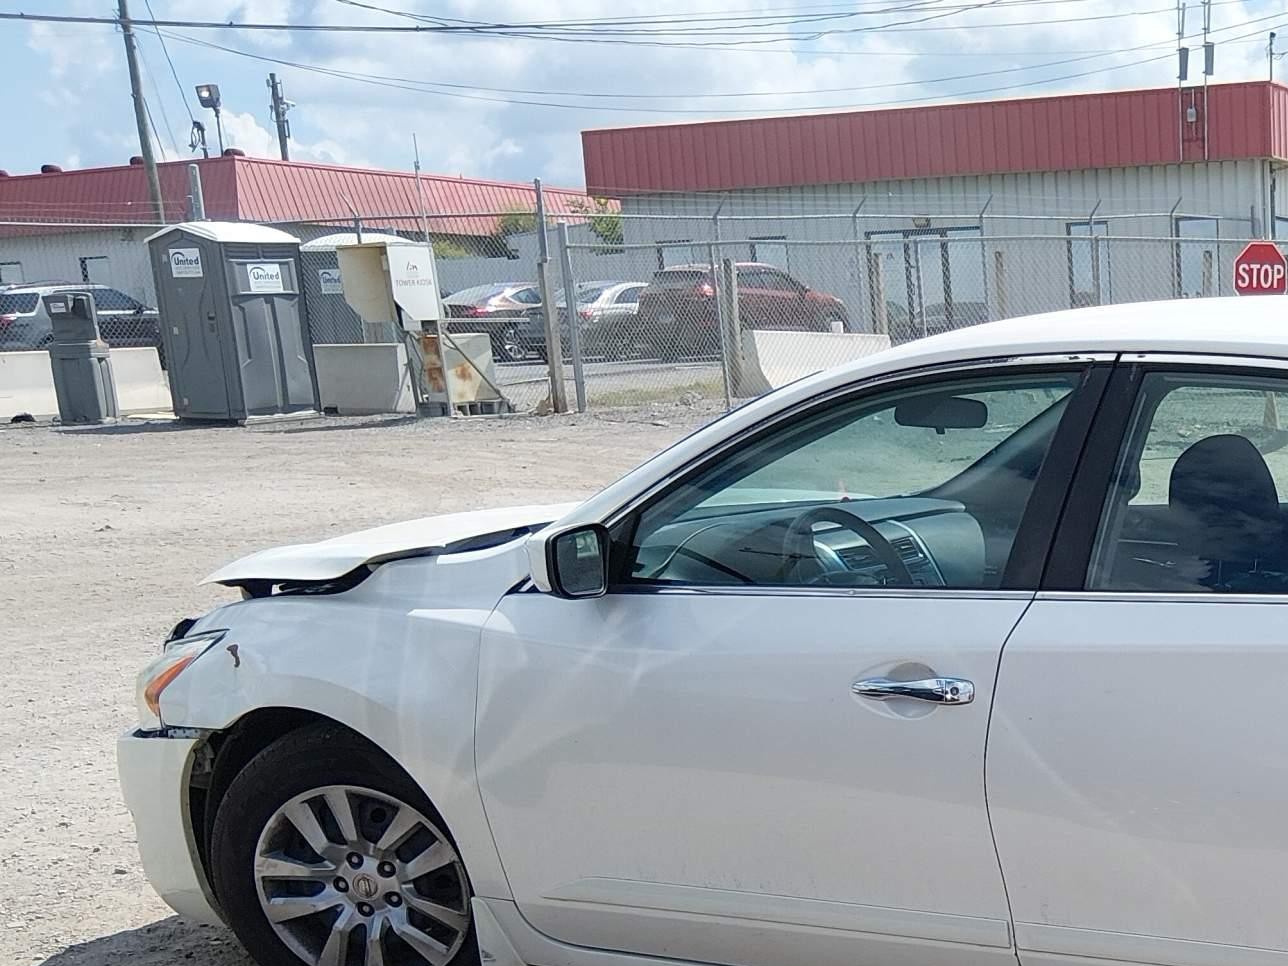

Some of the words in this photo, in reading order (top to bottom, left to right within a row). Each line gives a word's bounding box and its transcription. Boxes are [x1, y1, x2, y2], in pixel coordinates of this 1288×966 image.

[174, 256, 199, 266] United
[252, 271, 280, 281] United
[1237, 263, 1285, 288] STOP
[396, 279, 415, 287] TOWER
